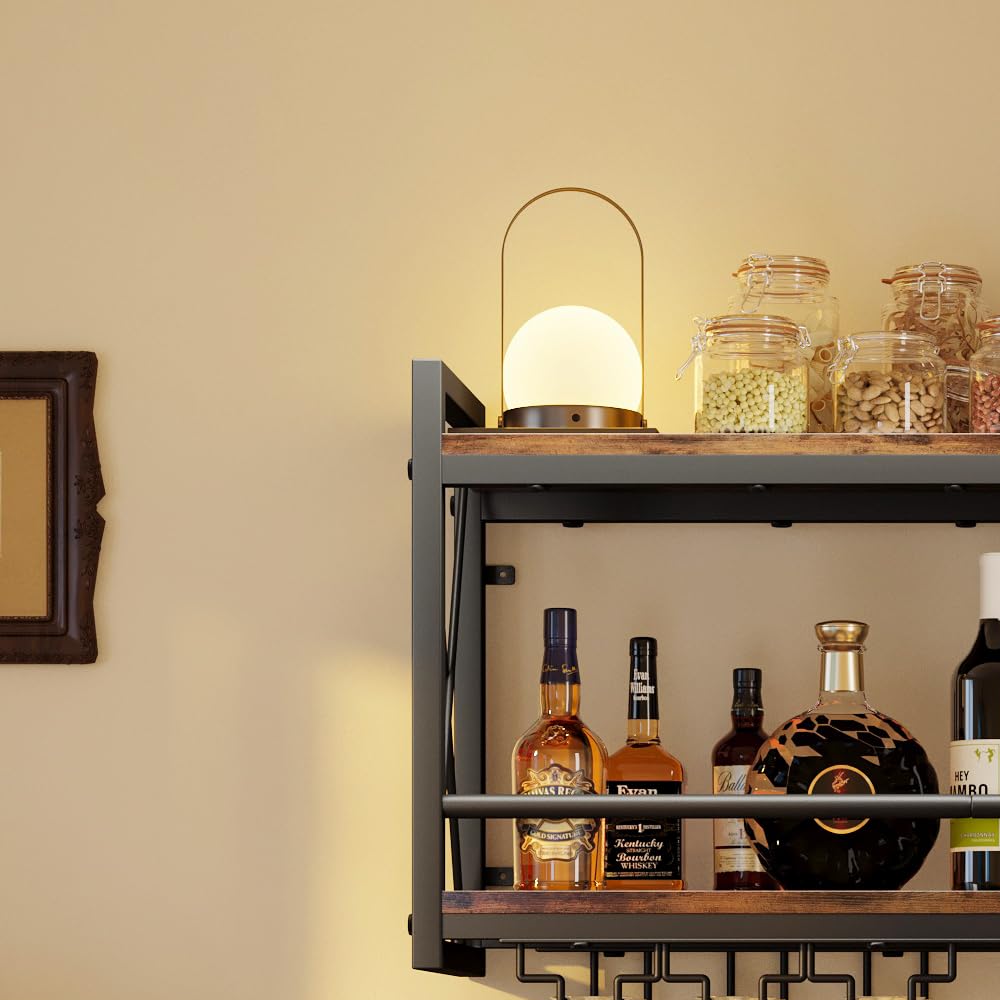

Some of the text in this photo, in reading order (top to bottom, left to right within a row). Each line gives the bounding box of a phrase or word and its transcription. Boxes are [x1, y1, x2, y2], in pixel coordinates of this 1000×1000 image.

[633, 668, 650, 681] Evan
[630, 681, 655, 694] Williams
[954, 770, 970, 781] HEY
[616, 784, 658, 795] Evan
[613, 838, 664, 850] Kentucky
[615, 852, 662, 862] Bourbon
[620, 862, 657, 870] WHISKEY
